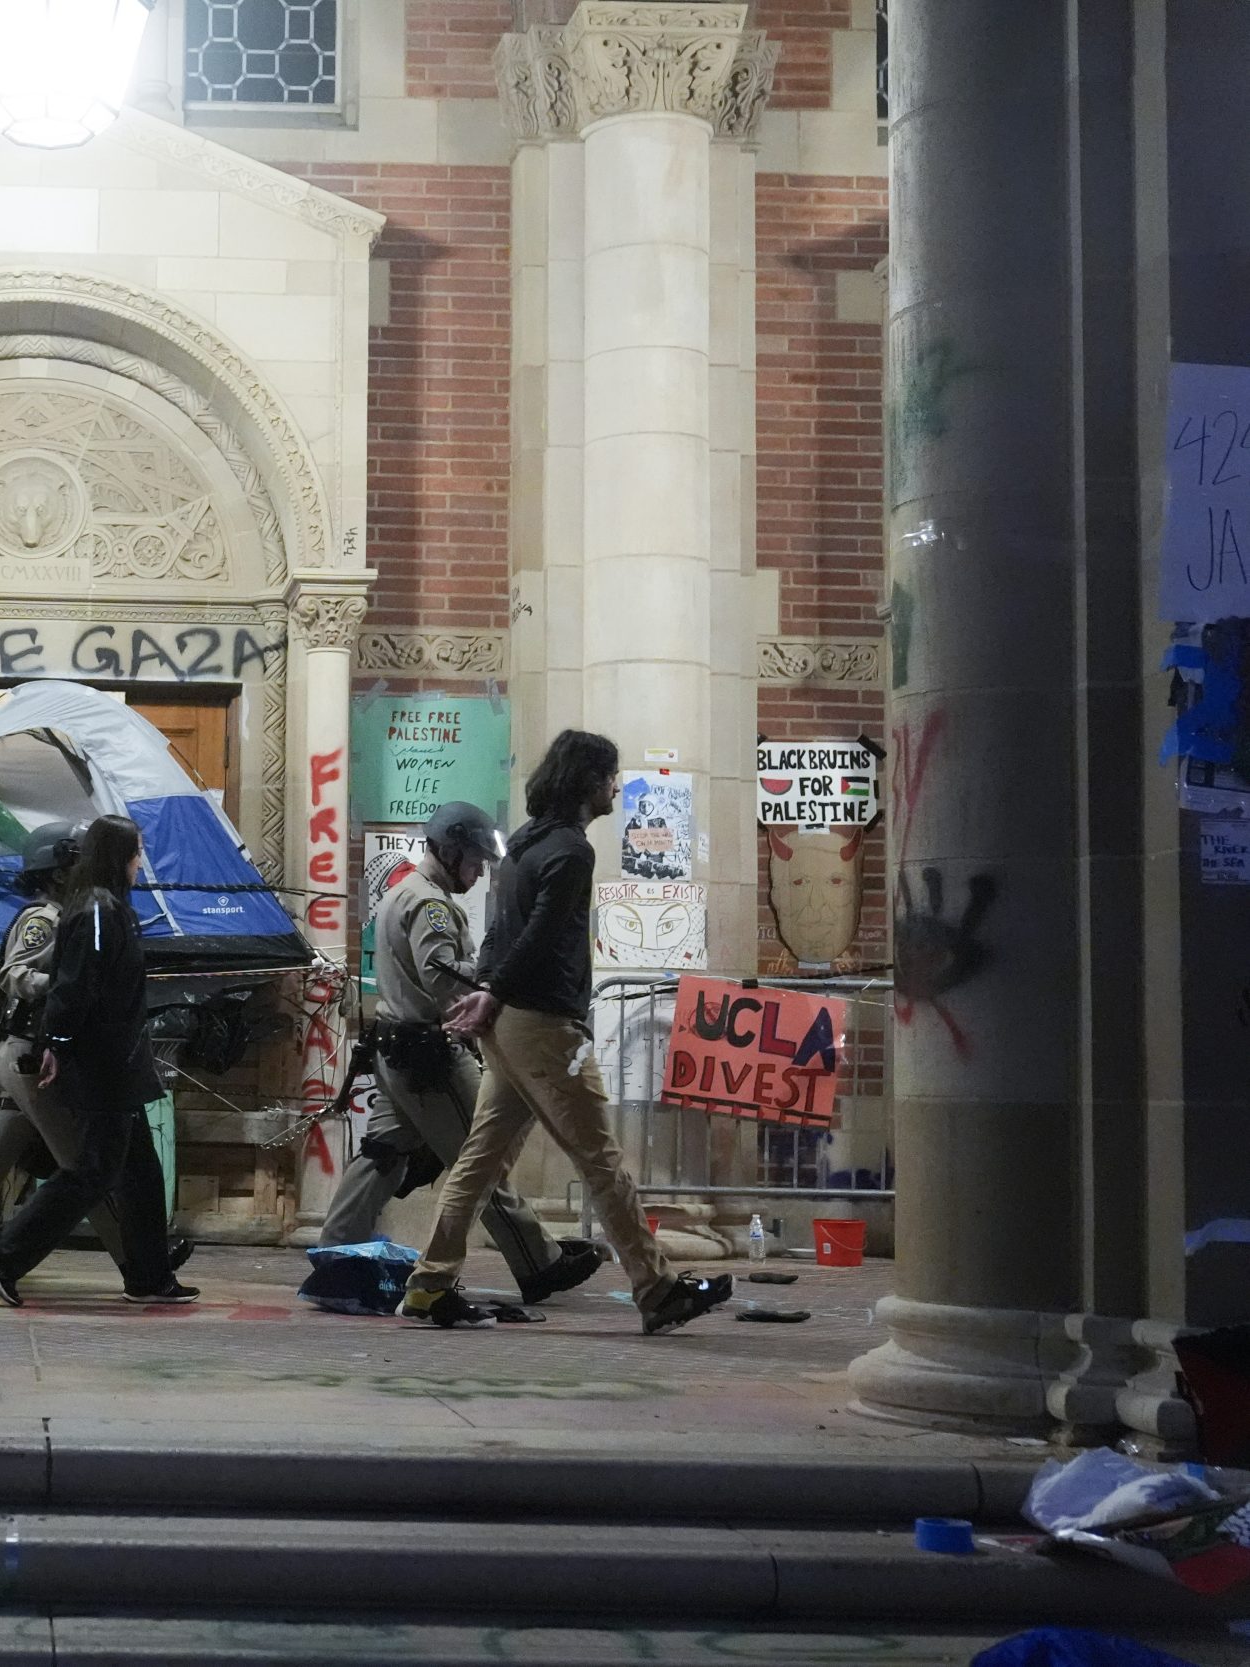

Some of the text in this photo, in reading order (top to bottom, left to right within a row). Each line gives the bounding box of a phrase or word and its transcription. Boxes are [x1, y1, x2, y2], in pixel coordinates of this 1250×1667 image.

[391, 711, 461, 724] FREE FREE
[388, 727, 462, 743] PALESTINE
[396, 758, 456, 771] WOMEN
[757, 749, 871, 771] BLACK BRUINS
[405, 776, 441, 793] LIFE
[799, 775, 833, 796] FOR
[390, 800, 441, 816] FREEDO
[761, 800, 869, 822] PALESTINE
[375, 835, 415, 852] THEY
[598, 884, 641, 902] RESISTIR
[662, 884, 704, 903] EXISTIR
[695, 989, 836, 1072] UCLA
[671, 1049, 831, 1112] DIVEST
